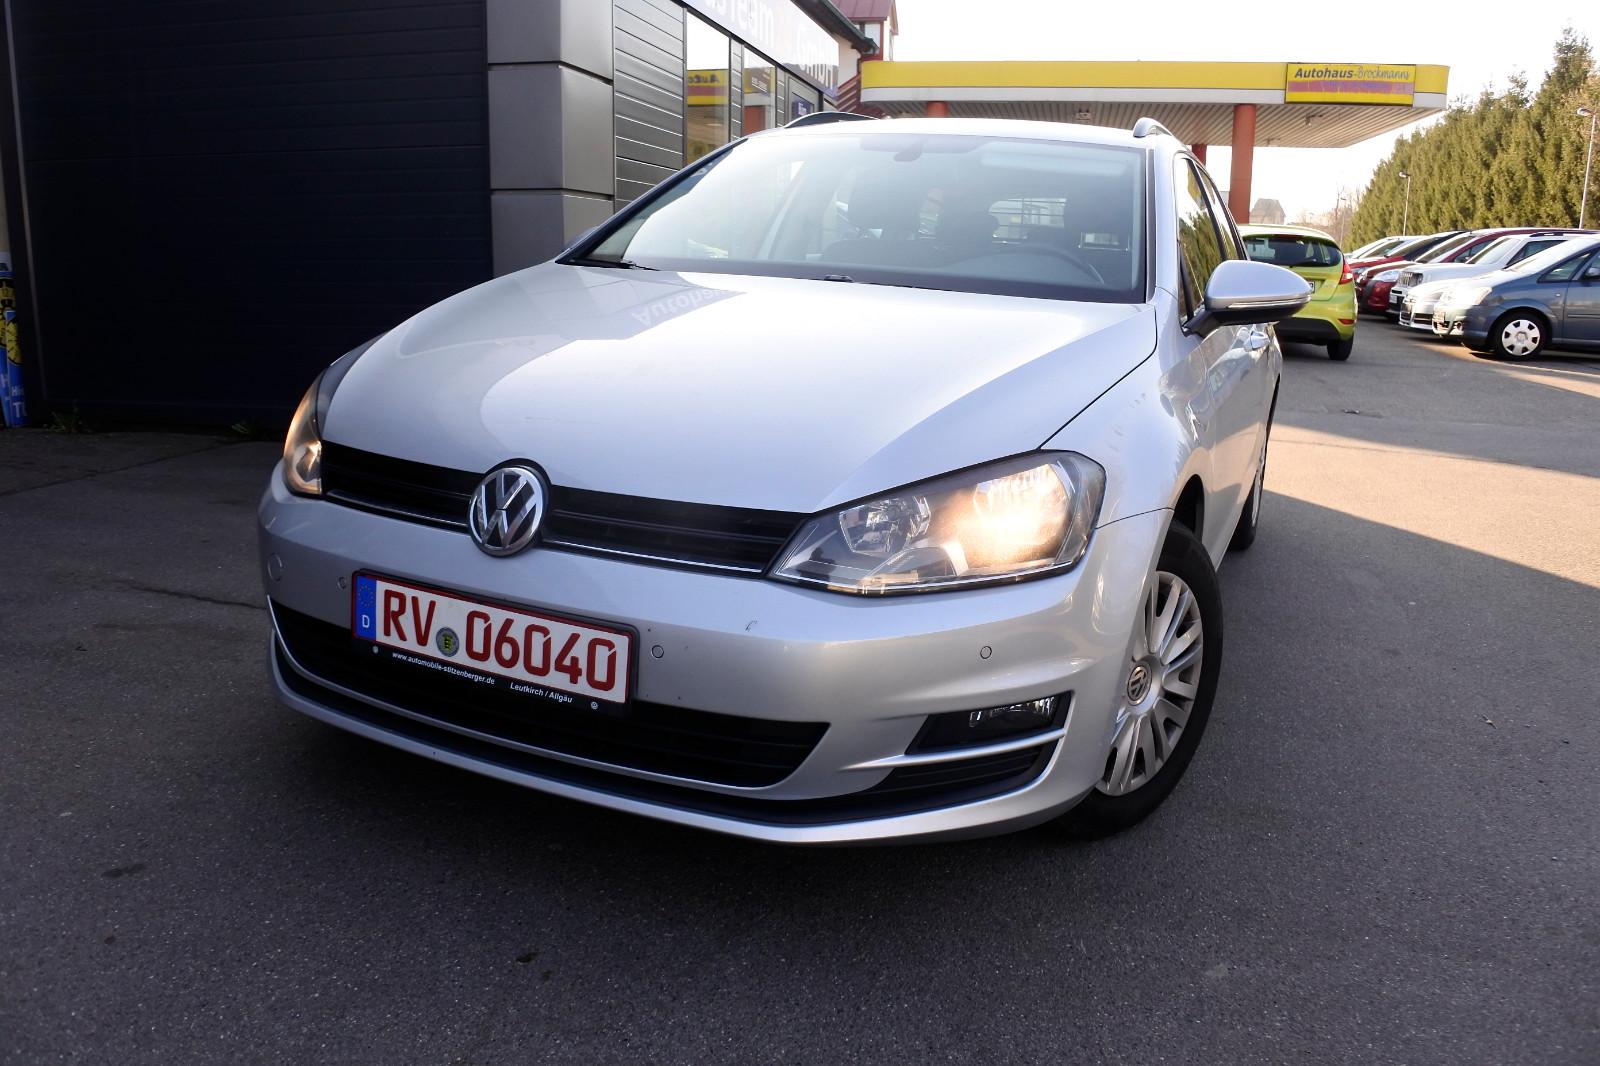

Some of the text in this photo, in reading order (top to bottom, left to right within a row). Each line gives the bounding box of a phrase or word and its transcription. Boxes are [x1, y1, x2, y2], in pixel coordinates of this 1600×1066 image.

[361, 614, 370, 629] D
[383, 588, 617, 692] RV 06040
[510, 681, 544, 697] Leutkirch
